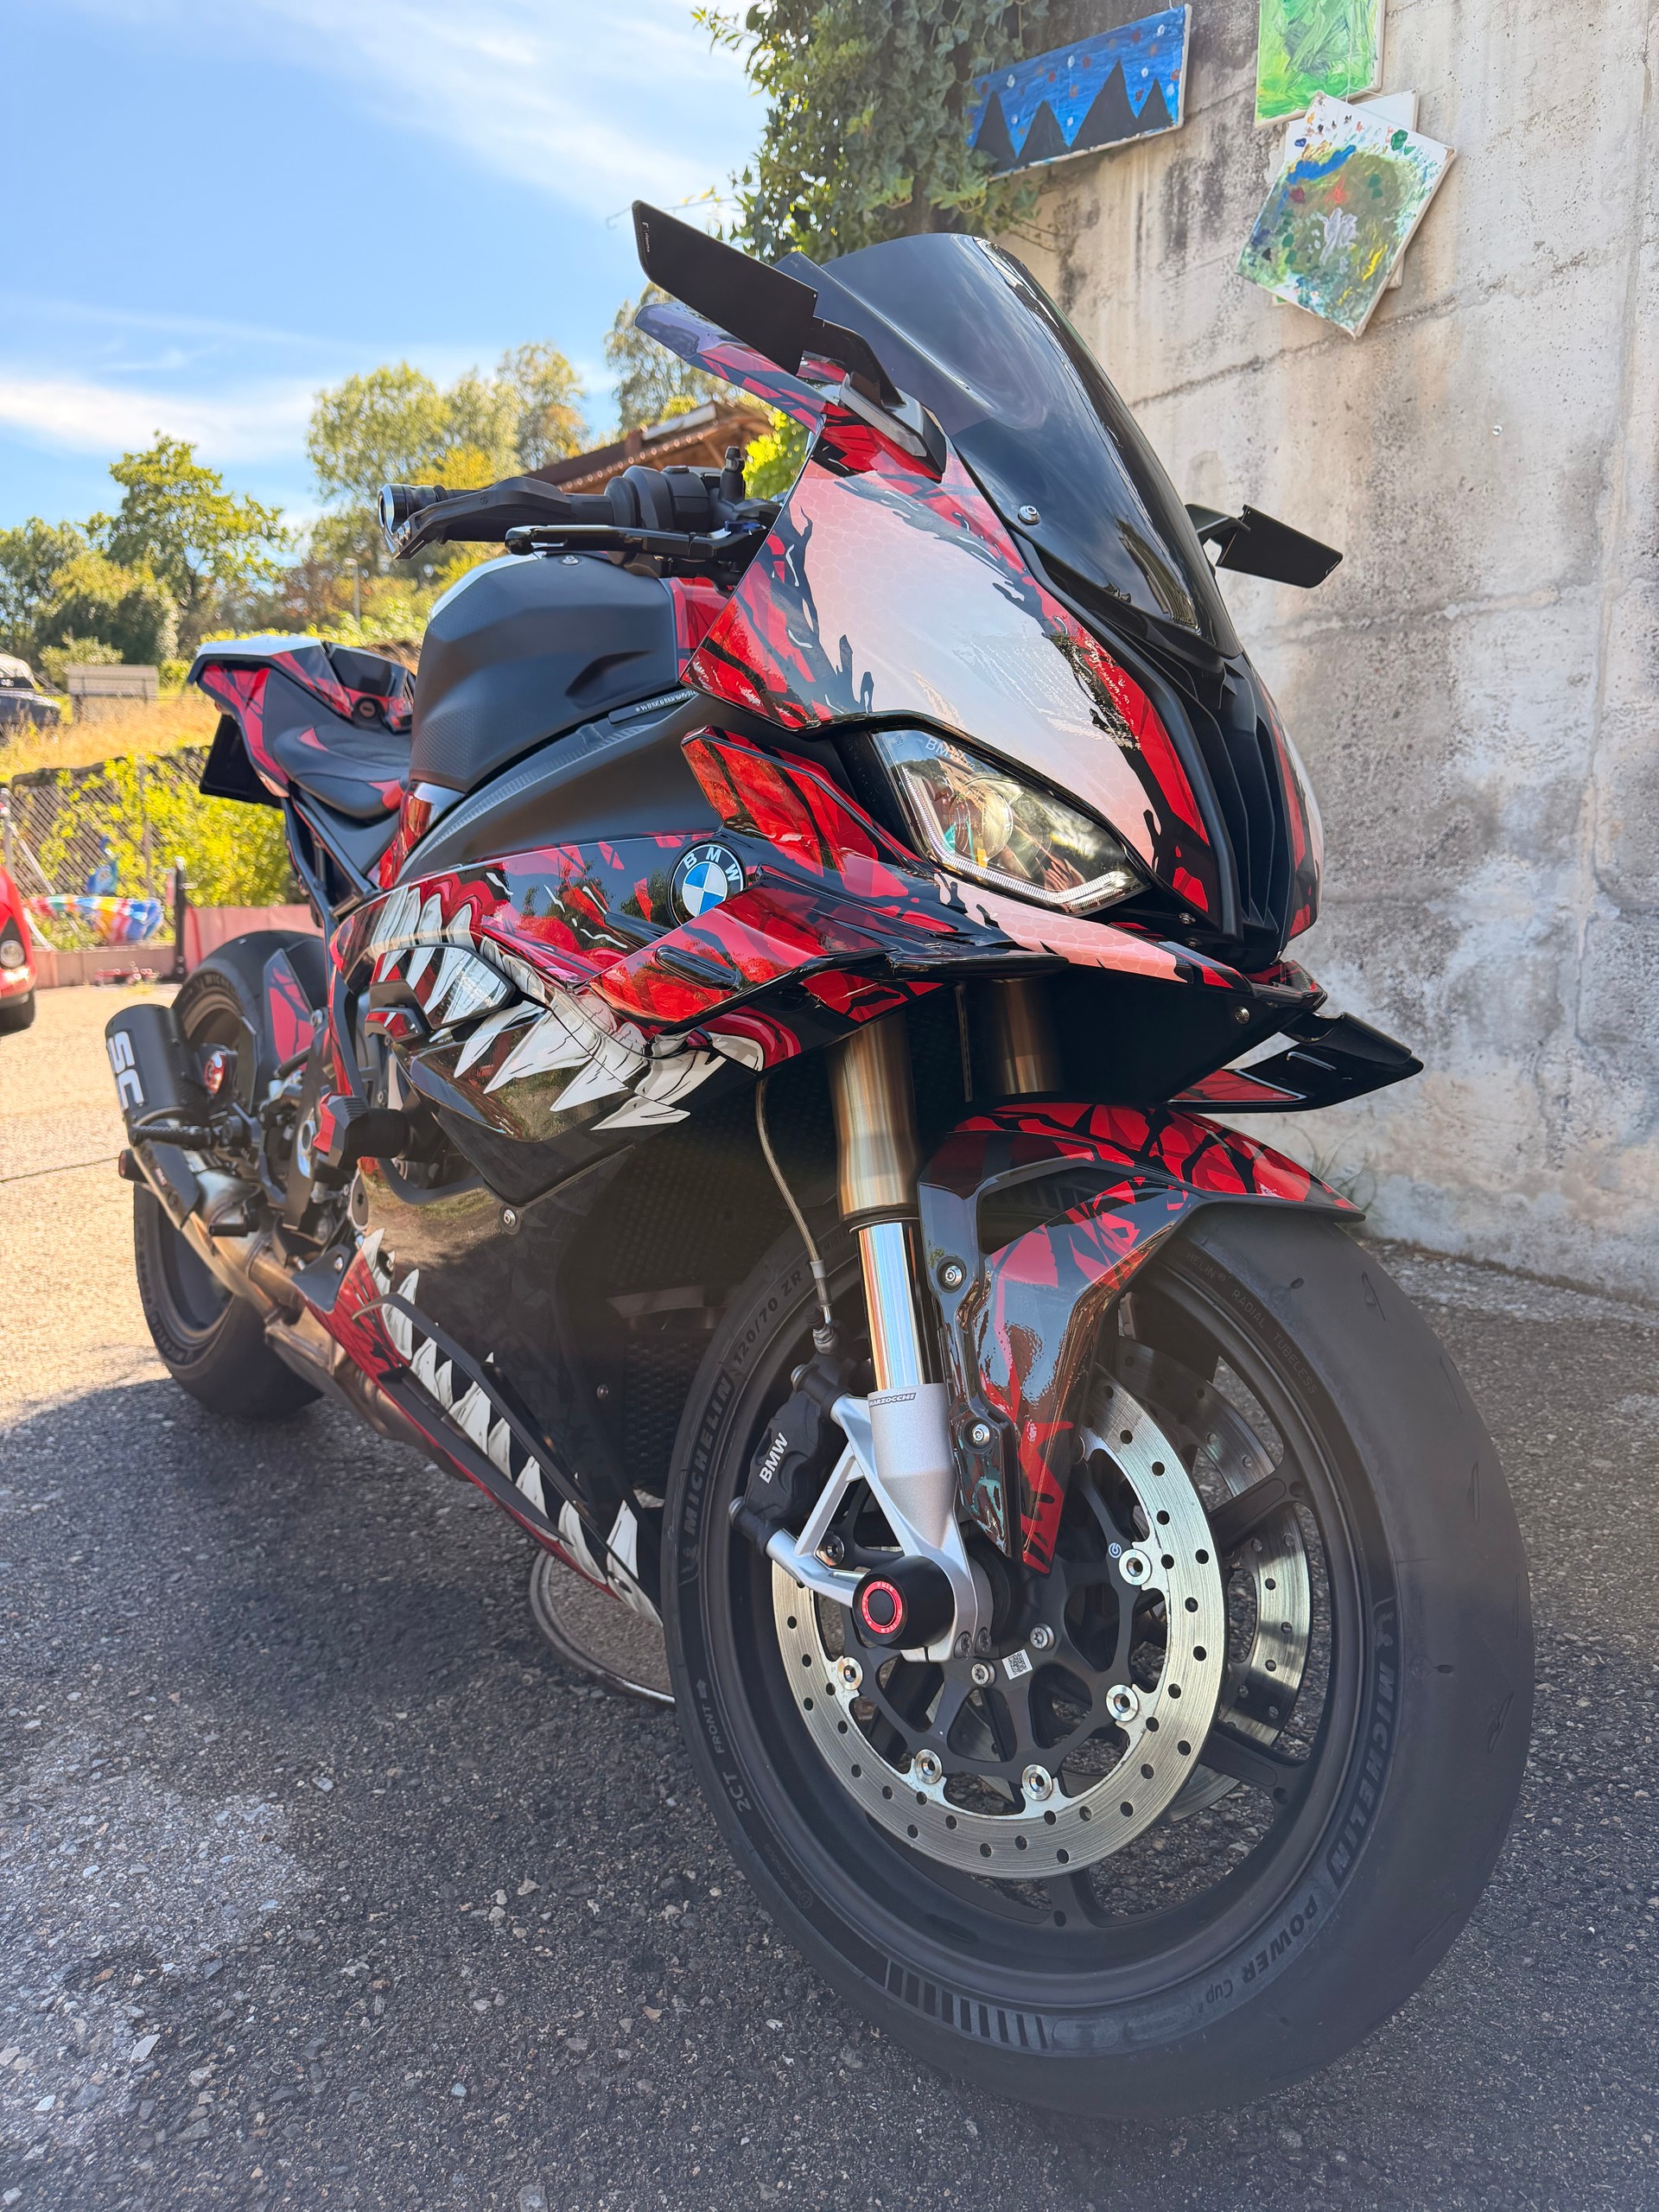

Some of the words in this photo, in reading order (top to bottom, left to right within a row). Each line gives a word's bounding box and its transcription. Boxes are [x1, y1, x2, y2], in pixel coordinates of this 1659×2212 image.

[683, 847, 740, 881] BMW
[107, 1031, 144, 1111] SC
[734, 1297, 778, 1365] 120/70
[781, 1270, 802, 1296] ZR
[1231, 1288, 1266, 1329] RADIAL
[1273, 1332, 1319, 1394] TUBELESS
[683, 1376, 733, 1536] MICHELIN
[760, 1432, 788, 1484] BMW
[702, 1705, 724, 1753] FRONT
[1331, 1662, 1394, 1875] MICHELIN
[722, 1771, 752, 1812] 2CT
[1242, 1894, 1319, 1984] POWER
[1206, 1978, 1233, 2004] Cup
